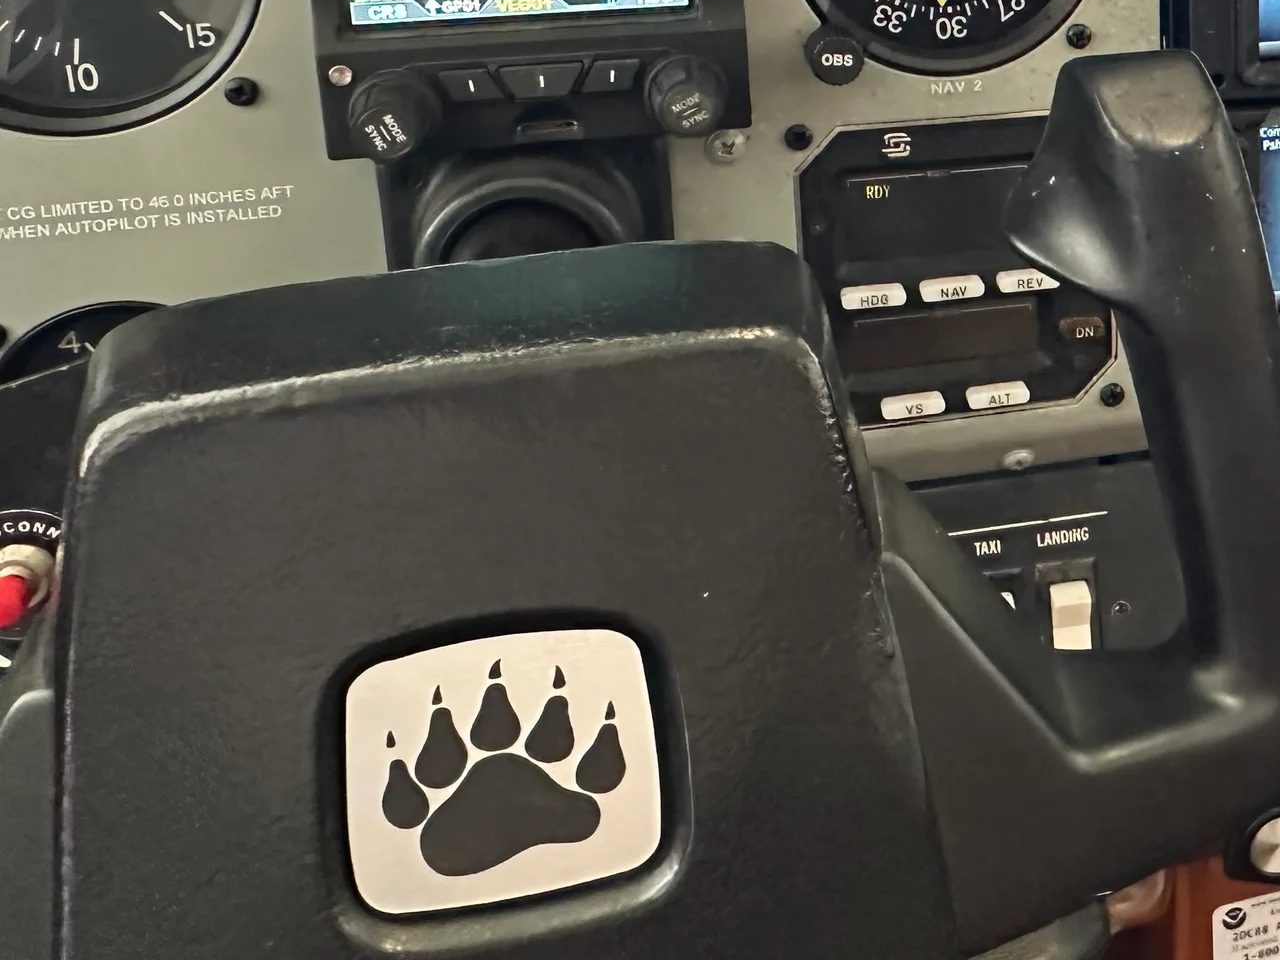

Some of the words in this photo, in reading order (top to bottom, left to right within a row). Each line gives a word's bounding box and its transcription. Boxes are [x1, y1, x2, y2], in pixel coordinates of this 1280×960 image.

[367, 4, 408, 21] CRS
[872, 3, 908, 34] 33
[184, 23, 216, 49] 15
[935, 15, 969, 41] 30
[820, 53, 853, 67] OBS
[65, 62, 100, 93] 10
[931, 81, 965, 95] NAV
[974, 79, 983, 92] 2
[7, 206, 37, 222] CG
[41, 199, 114, 219] LIMITED
[118, 197, 143, 212] TO
[189, 187, 256, 208] INCHES
[260, 185, 295, 201] AFT
[866, 185, 891, 200] RDY
[55, 214, 160, 237] AUTOPILOT
[164, 214, 182, 227] IS
[187, 205, 283, 225] INSTALLED
[860, 294, 890, 307] HDG
[940, 286, 967, 299] NAV
[1017, 277, 1044, 289] REV
[1075, 326, 1095, 339] DN
[905, 403, 924, 416] VS
[988, 392, 1012, 407] ALT
[974, 539, 1001, 558] TAXI
[1036, 527, 1090, 548] LANDING
